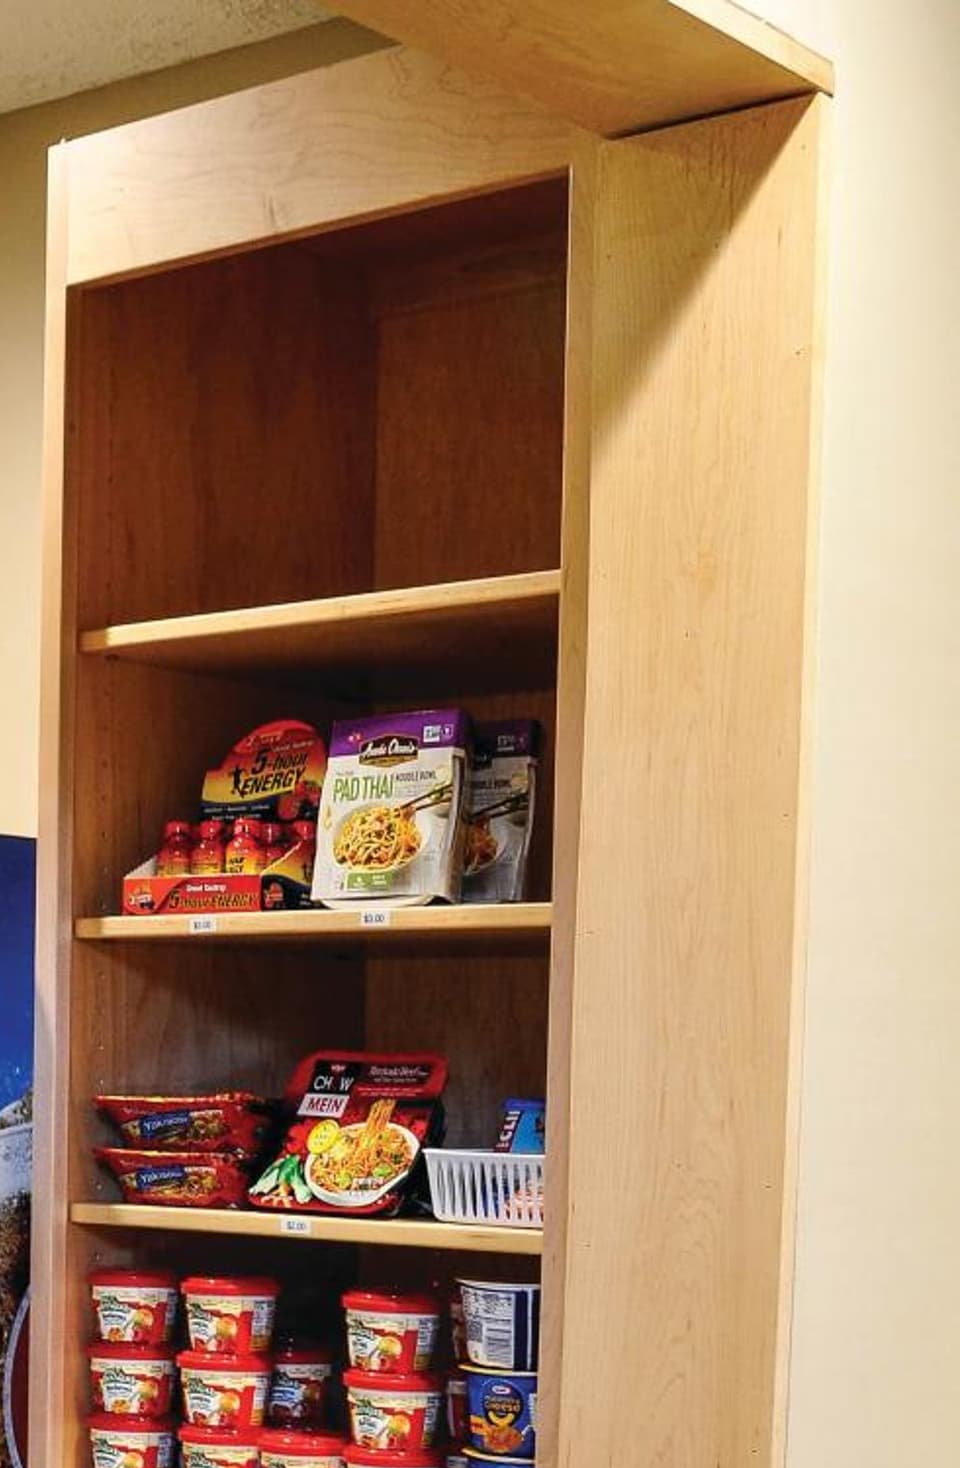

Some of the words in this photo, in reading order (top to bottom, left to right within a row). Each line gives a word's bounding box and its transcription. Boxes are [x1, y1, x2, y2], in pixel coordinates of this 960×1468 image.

[241, 767, 306, 796] ENERGY
[333, 777, 360, 802] PAD
[361, 773, 393, 799] THAI
[313, 1075, 354, 1091] CHW
[306, 1097, 342, 1113] MEIN
